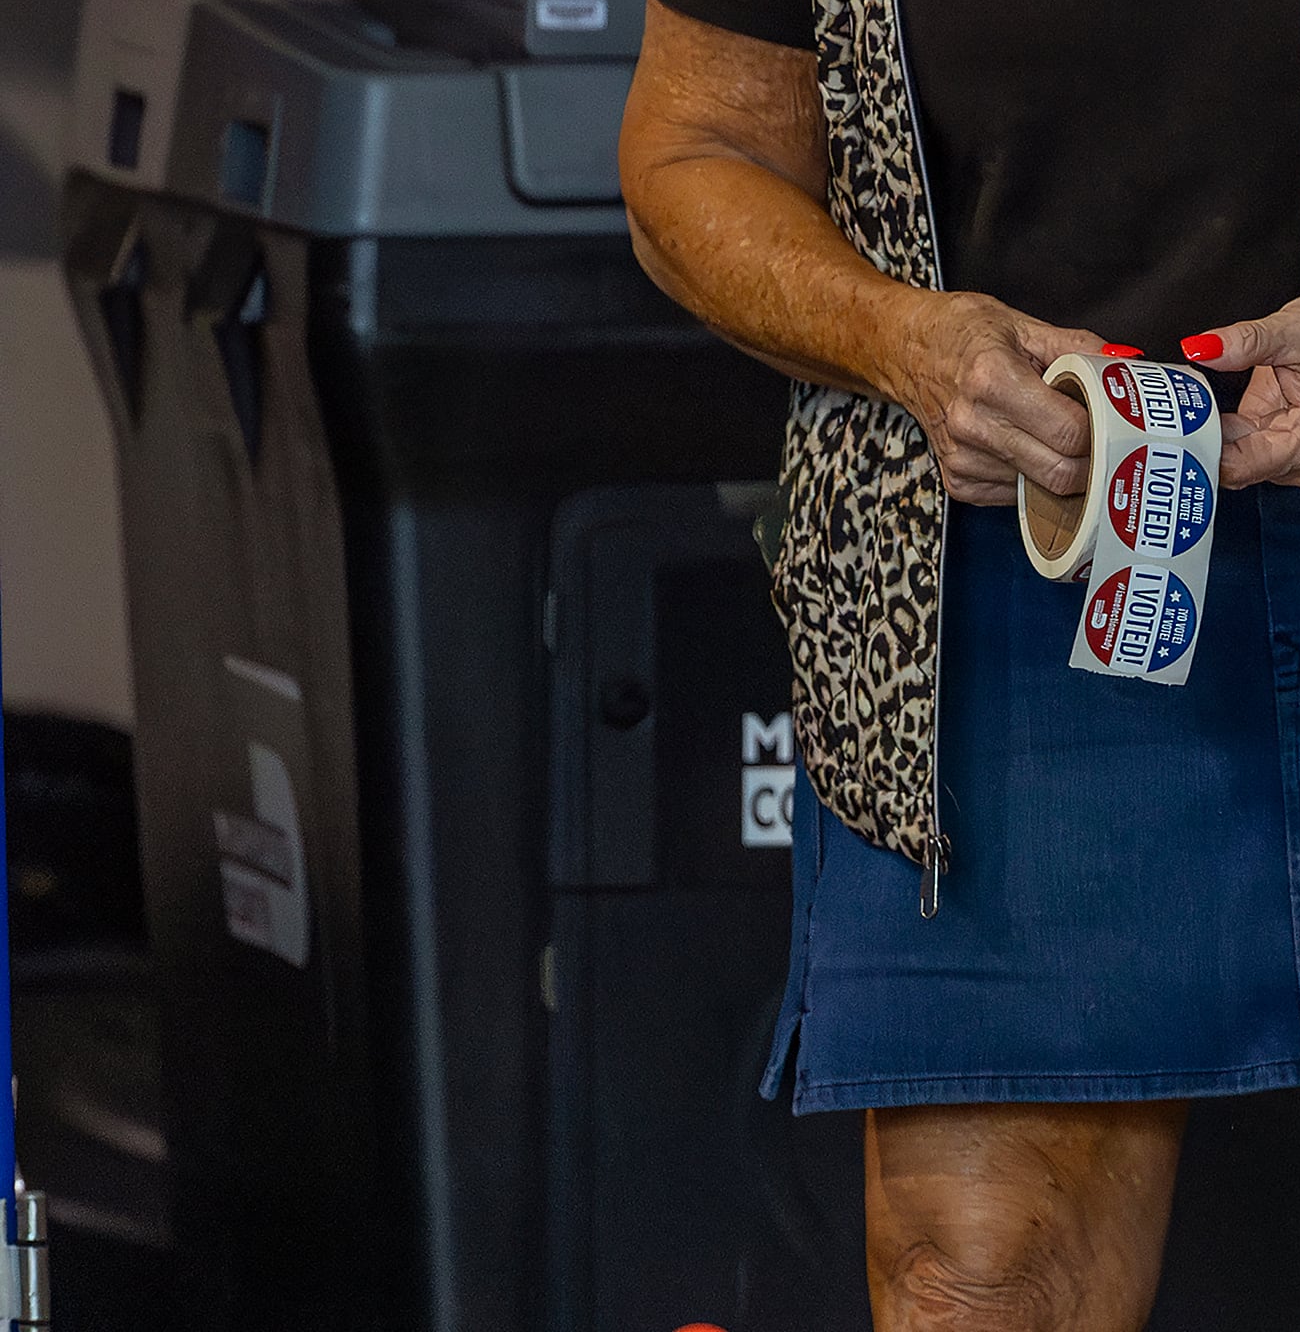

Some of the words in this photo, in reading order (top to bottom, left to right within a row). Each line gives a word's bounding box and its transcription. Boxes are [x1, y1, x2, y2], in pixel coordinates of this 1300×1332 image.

[1136, 372, 1177, 430] VOTED!
[1152, 451, 1178, 460] I
[1141, 468, 1177, 549] VOTED!
[1135, 572, 1163, 581] I
[1116, 589, 1161, 666] VOTED!
